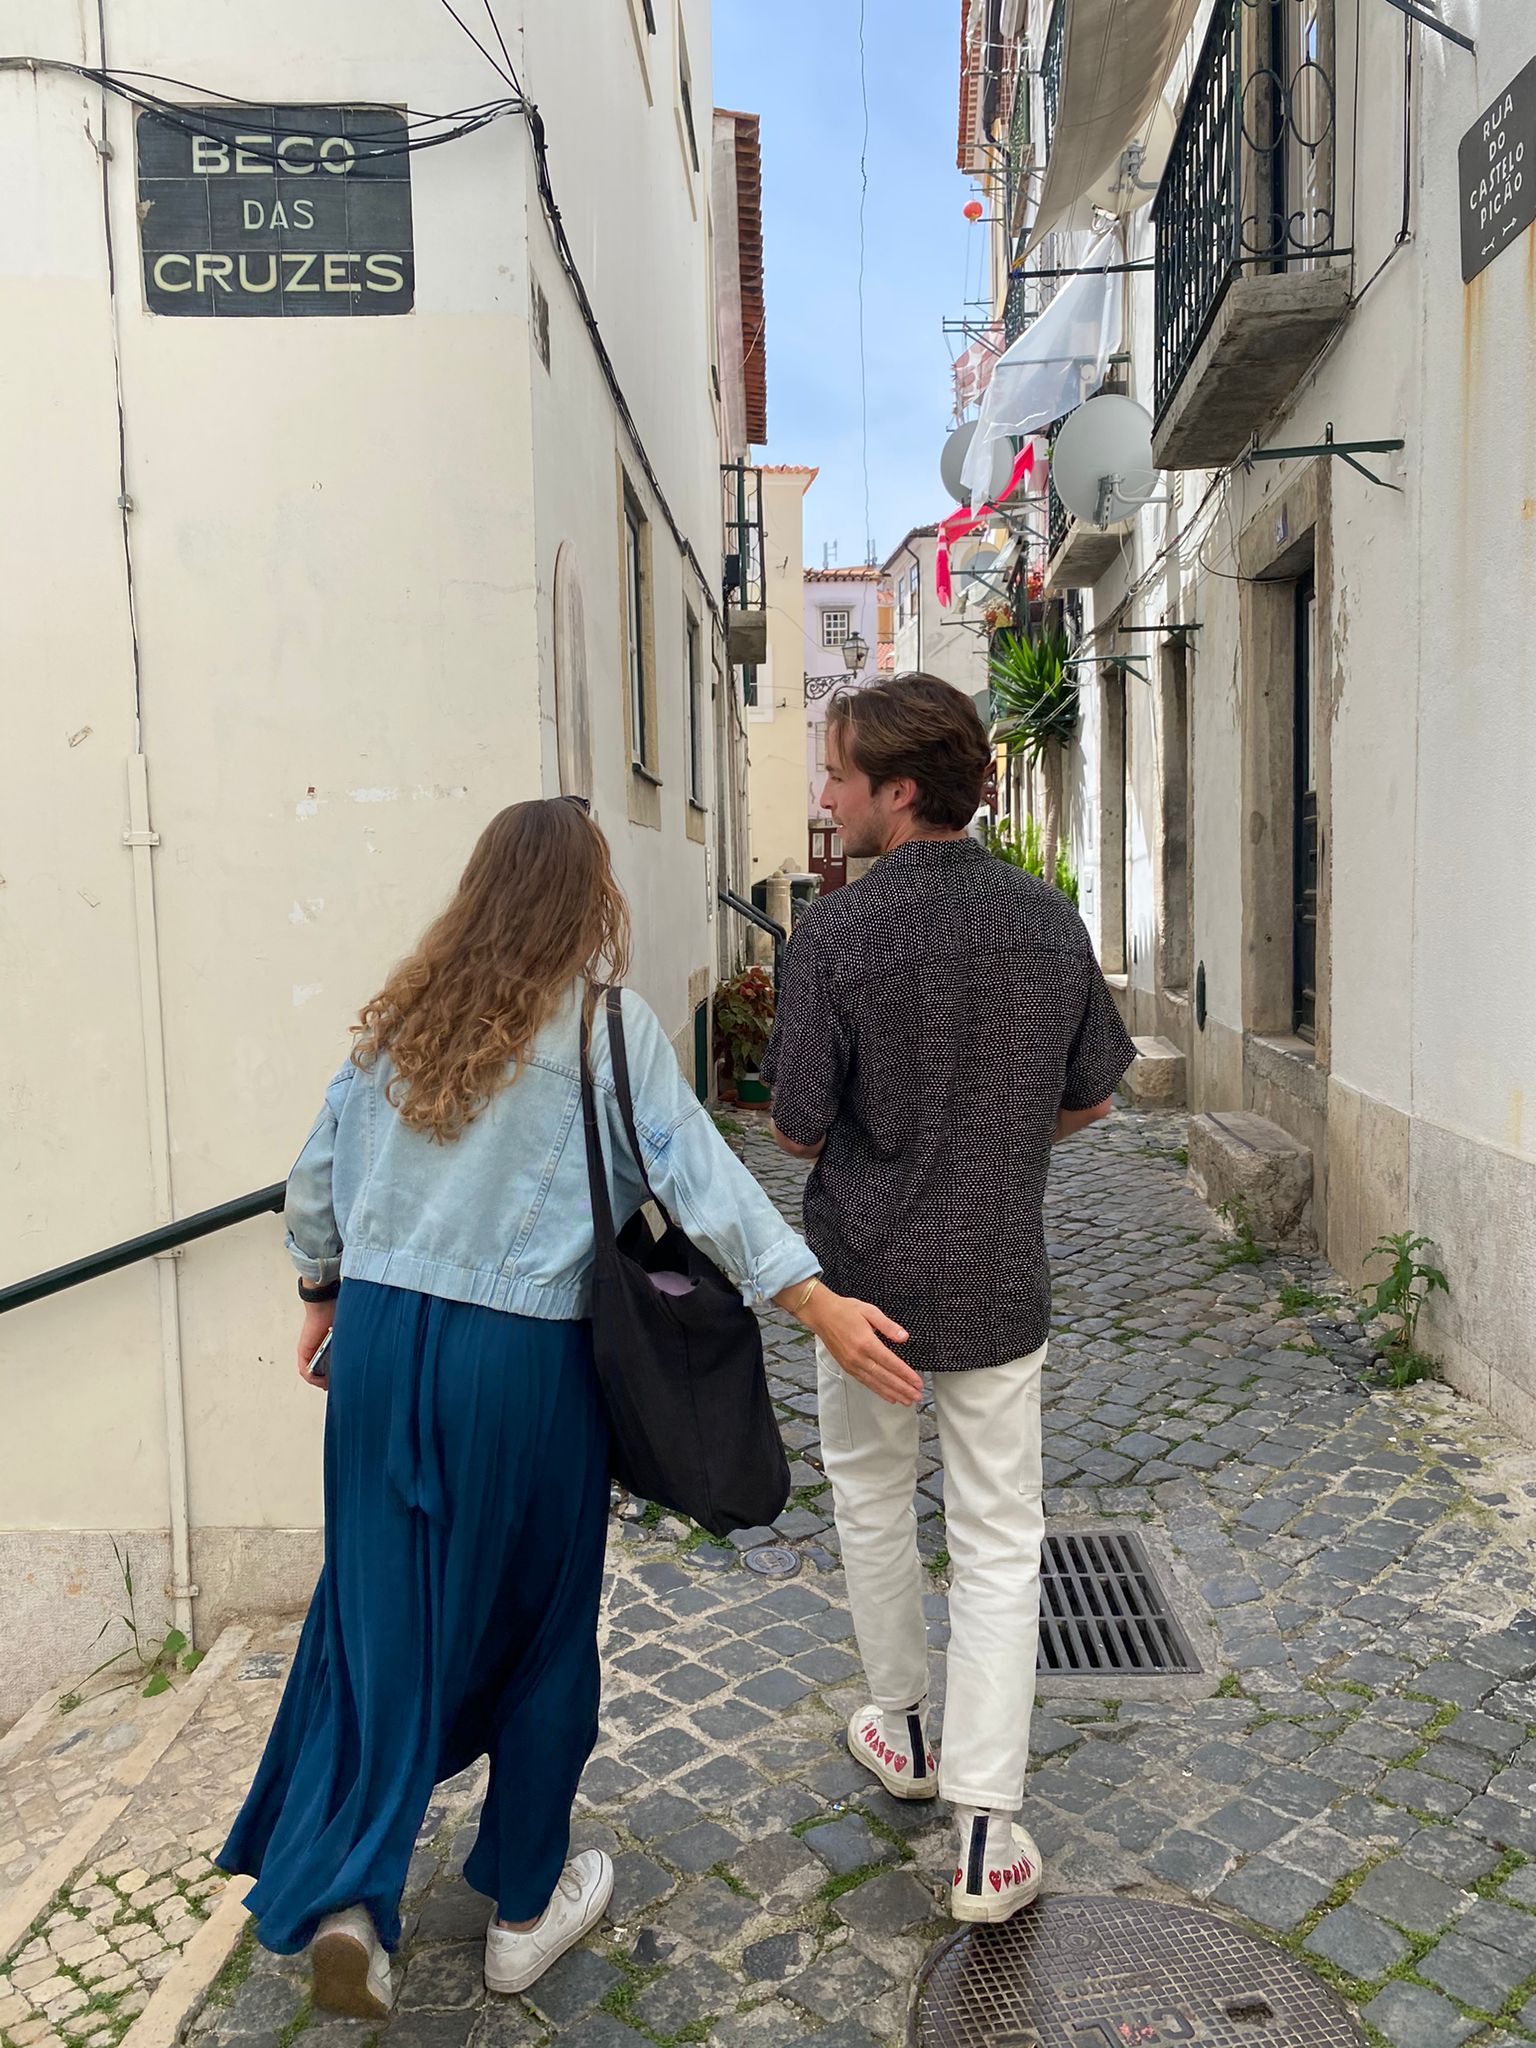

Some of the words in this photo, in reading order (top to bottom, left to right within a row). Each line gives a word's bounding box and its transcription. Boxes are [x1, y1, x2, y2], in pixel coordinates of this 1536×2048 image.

[1482, 93, 1514, 142] RUA
[191, 135, 356, 174] BECO
[1489, 131, 1506, 162] DO
[1469, 141, 1524, 211] CASTELO
[243, 200, 315, 230] DAS
[1480, 172, 1523, 230] PICÃO
[153, 254, 405, 293] CRUZES
